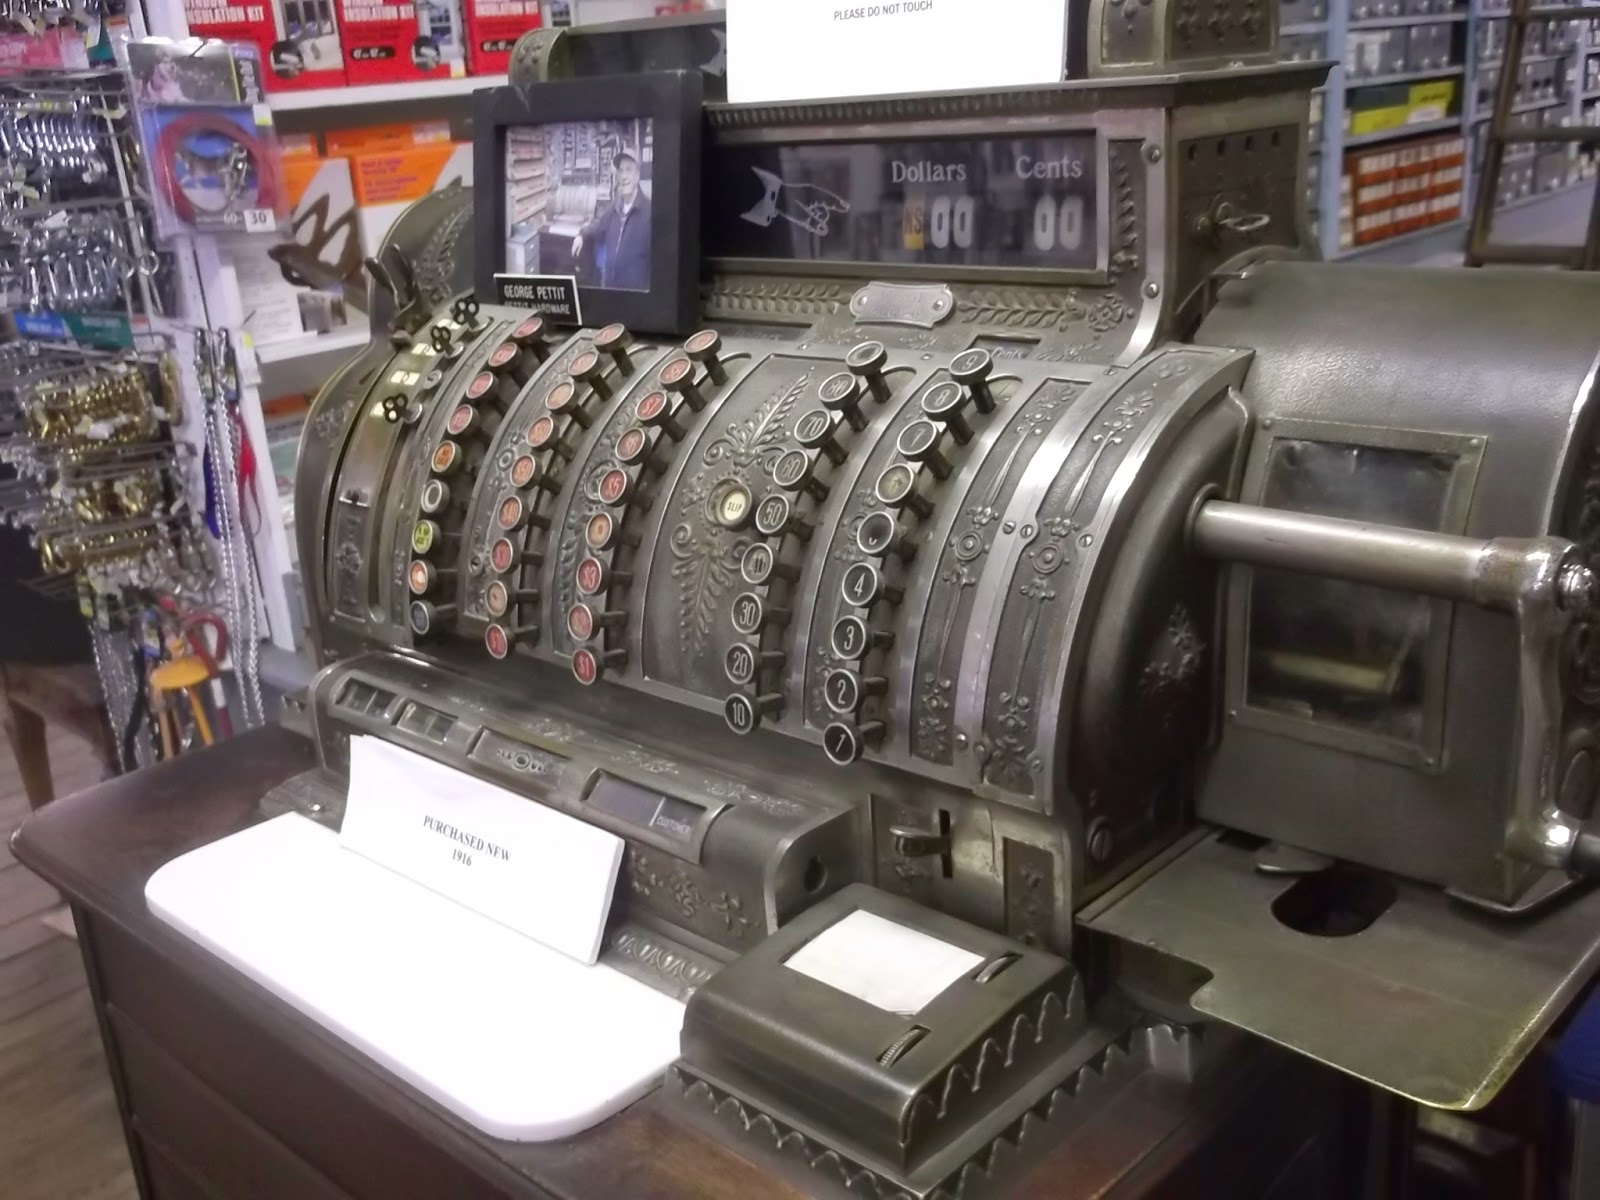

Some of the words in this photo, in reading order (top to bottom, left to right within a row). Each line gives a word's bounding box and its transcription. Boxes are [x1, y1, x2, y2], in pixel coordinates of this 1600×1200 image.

[186, 6, 245, 24] NSULATION
[247, 6, 264, 22] KIT
[834, 8, 865, 20] PLEASE
[868, 6, 880, 17] DO
[882, 3, 900, 15] NOT
[903, 0, 932, 12] TOUCH
[892, 160, 967, 183] Dollars
[1015, 154, 1082, 179] Cents
[931, 196, 974, 249] 00
[1034, 195, 1084, 250] 00
[504, 284, 535, 299] GEORGE
[536, 285, 565, 300] PETTIT
[962, 355, 978, 371] 9
[934, 388, 949, 407] 8
[803, 416, 825, 437] 70
[910, 428, 927, 448] 7
[781, 458, 800, 479] 60
[726, 499, 743, 513] SLIP
[763, 502, 783, 526] 50
[853, 572, 866, 598] 4
[739, 600, 756, 626] 30
[843, 625, 855, 651] 3
[732, 650, 749, 677] 20
[837, 678, 847, 705] 2
[732, 701, 746, 727] 10
[835, 733, 847, 753] 1
[424, 815, 484, 851] PURCHASED
[486, 842, 511, 861] NEW
[453, 848, 472, 867] 1916
